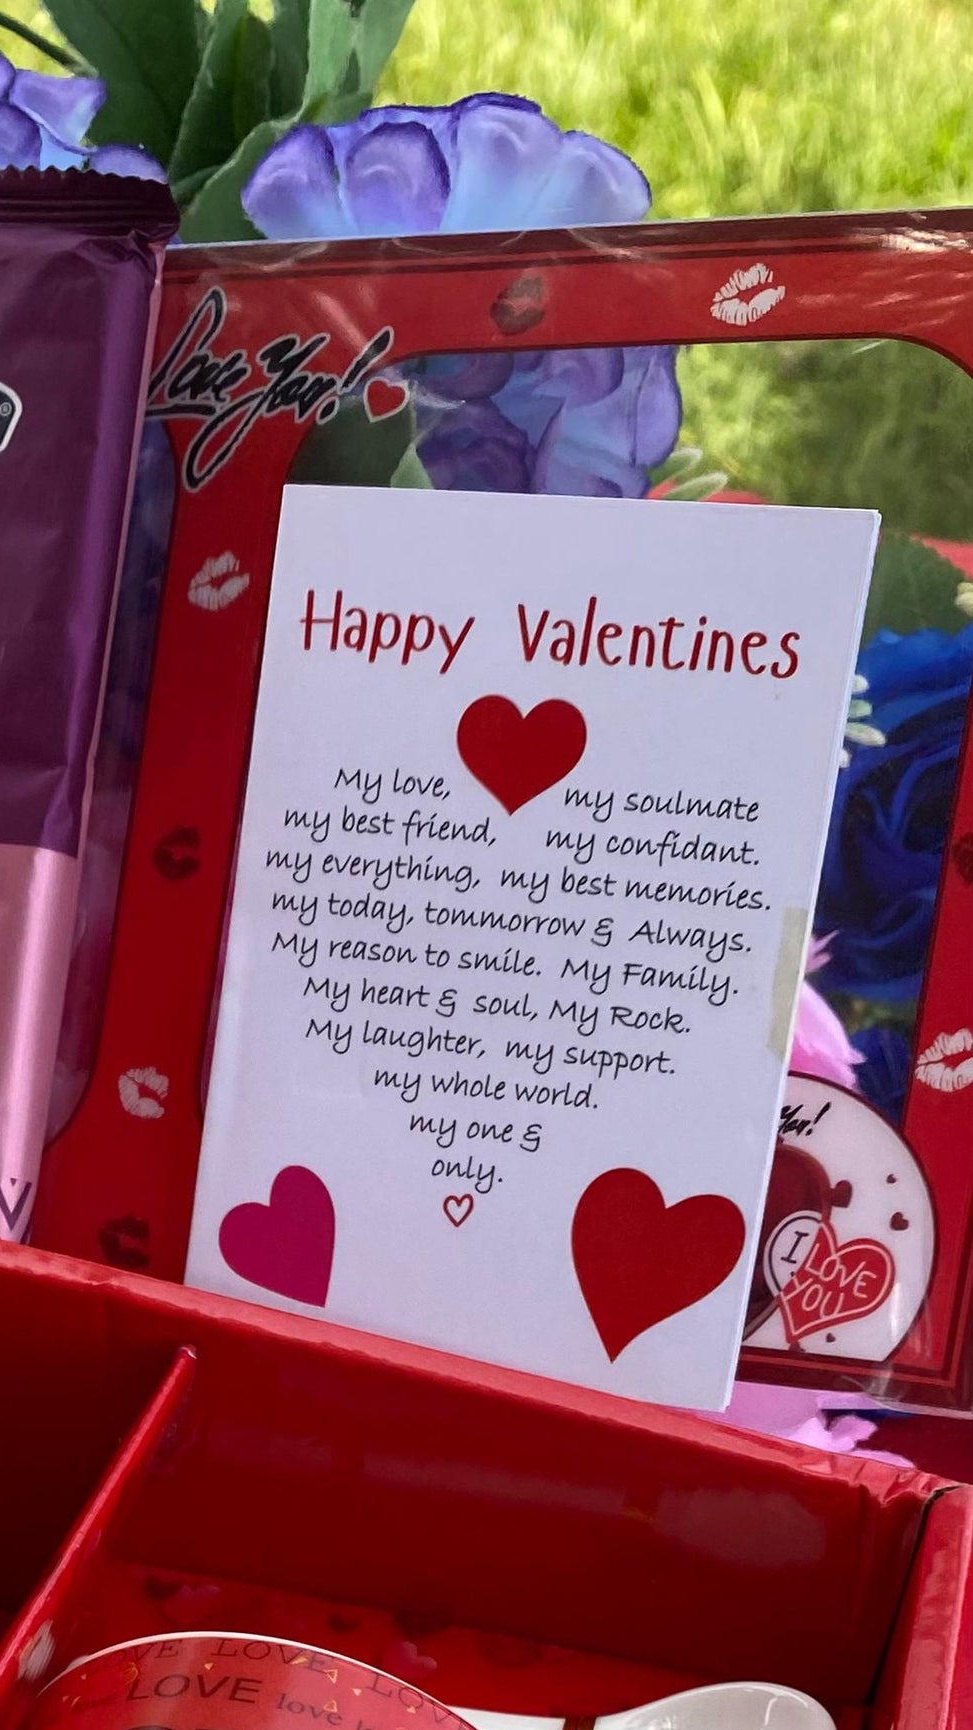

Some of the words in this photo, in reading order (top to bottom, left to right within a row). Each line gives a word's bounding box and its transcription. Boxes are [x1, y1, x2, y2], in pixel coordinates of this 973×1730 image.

[300, 589, 475, 674] Happy
[518, 597, 801, 679] Valentines
[335, 768, 382, 804] My
[394, 768, 451, 799] love,
[564, 786, 614, 822] my
[623, 790, 759, 822] soulmate
[285, 808, 330, 844] my
[342, 805, 393, 836] best
[402, 811, 495, 847] friend,
[546, 827, 596, 865] my
[607, 831, 760, 867] confidant.
[266, 847, 311, 883] my
[322, 852, 480, 891] everything,
[500, 867, 549, 903] my
[561, 865, 615, 897] best
[626, 876, 771, 912] memories.
[272, 890, 317, 926] my
[426, 900, 585, 936] tommorrow
[595, 917, 614, 946] &
[629, 919, 751, 954] Always.
[272, 932, 318, 967] My
[328, 937, 417, 965] reason
[426, 944, 450, 968] to
[459, 947, 542, 978] smile.
[561, 958, 612, 994] My
[624, 962, 739, 1006] Family.
[304, 977, 350, 1012] My
[362, 976, 429, 1008] heart
[438, 989, 457, 1017] &
[473, 992, 539, 1023] soul,
[549, 998, 599, 1036] My
[611, 1005, 691, 1034] Rock.
[306, 1018, 353, 1054] My
[363, 1022, 485, 1059] laughter,
[506, 1041, 555, 1074] my
[563, 1045, 675, 1078] support.
[374, 1068, 421, 1102] my
[432, 1070, 506, 1100] whole
[515, 1079, 598, 1110] world.
[410, 1113, 456, 1148] my
[467, 1118, 514, 1144] one
[523, 1123, 542, 1151] &
[431, 1158, 503, 1194] only.
[781, 1231, 809, 1263] I
[805, 1243, 877, 1298] LOVE
[785, 1275, 844, 1320] YOU
[127, 1674, 263, 1704] LOVE
[276, 1692, 343, 1726] love
